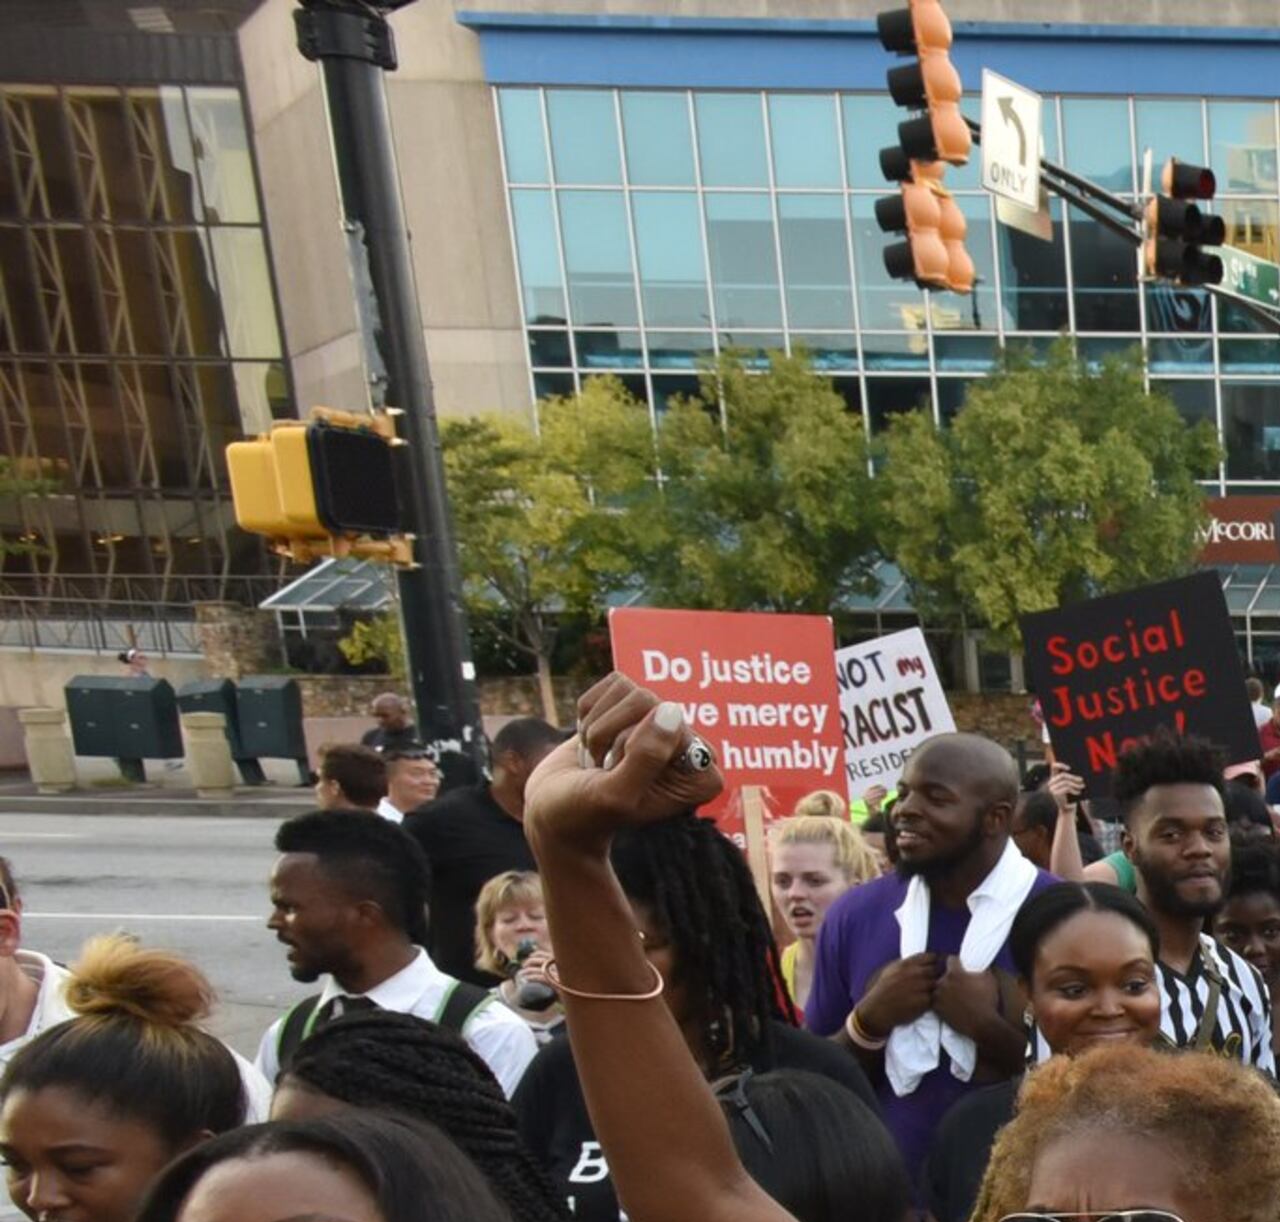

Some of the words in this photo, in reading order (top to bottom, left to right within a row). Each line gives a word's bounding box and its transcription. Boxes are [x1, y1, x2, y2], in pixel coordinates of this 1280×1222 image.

[990, 161, 1028, 193] ONLY
[1046, 608, 1184, 676] Social
[641, 650, 692, 682] Do
[699, 651, 811, 688] justice
[837, 650, 886, 693] NOT
[896, 654, 926, 679] my
[682, 701, 718, 727] ve
[727, 702, 829, 733] mercy
[841, 687, 933, 747] RACIST
[1051, 667, 1207, 729] Justice
[721, 740, 838, 775] humbly
